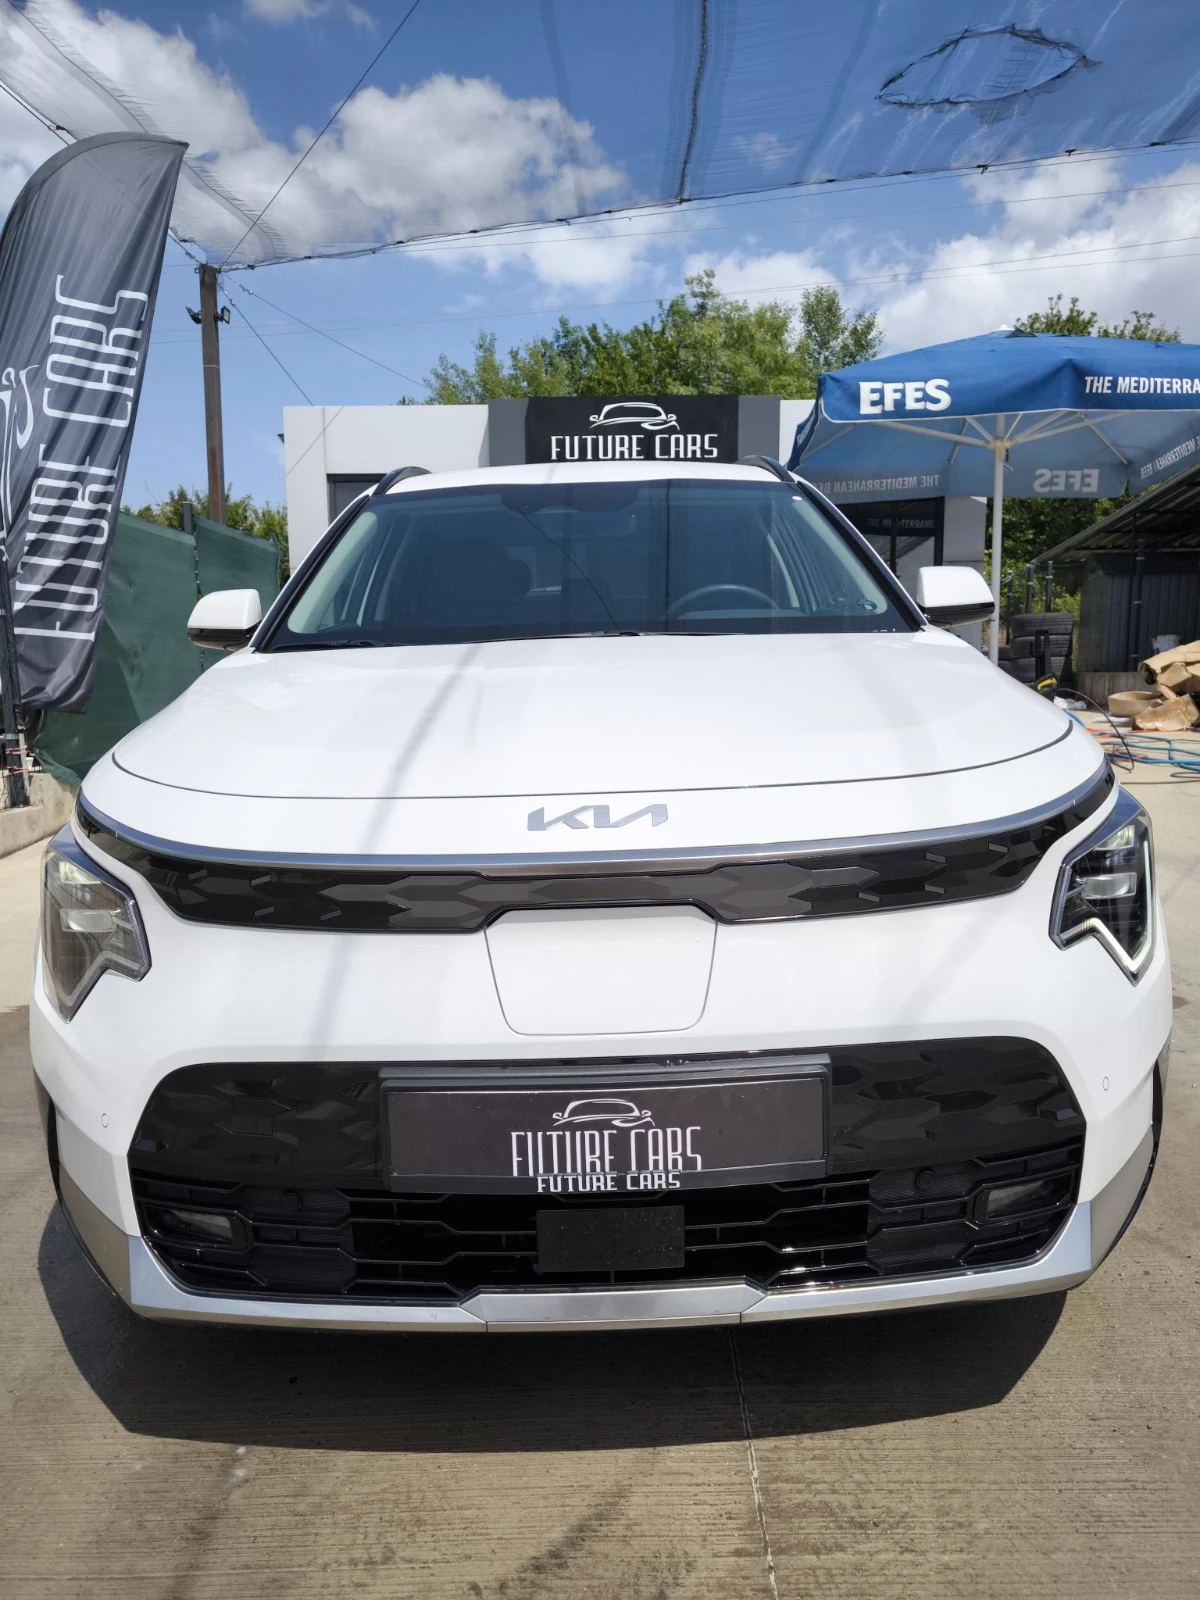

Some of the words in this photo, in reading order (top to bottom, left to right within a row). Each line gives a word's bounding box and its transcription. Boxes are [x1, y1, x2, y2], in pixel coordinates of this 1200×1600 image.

[42, 274, 149, 428] CARS
[859, 378, 952, 415] EFES
[1085, 377, 1112, 393] THE
[551, 434, 644, 460] FUTURE
[655, 433, 718, 458] CARS
[14, 442, 122, 641] FUTURE
[511, 1130, 618, 1177] FUTURE
[630, 1126, 702, 1173] CARS
[537, 1173, 618, 1192] FUTURE
[627, 1172, 681, 1190] CARS
